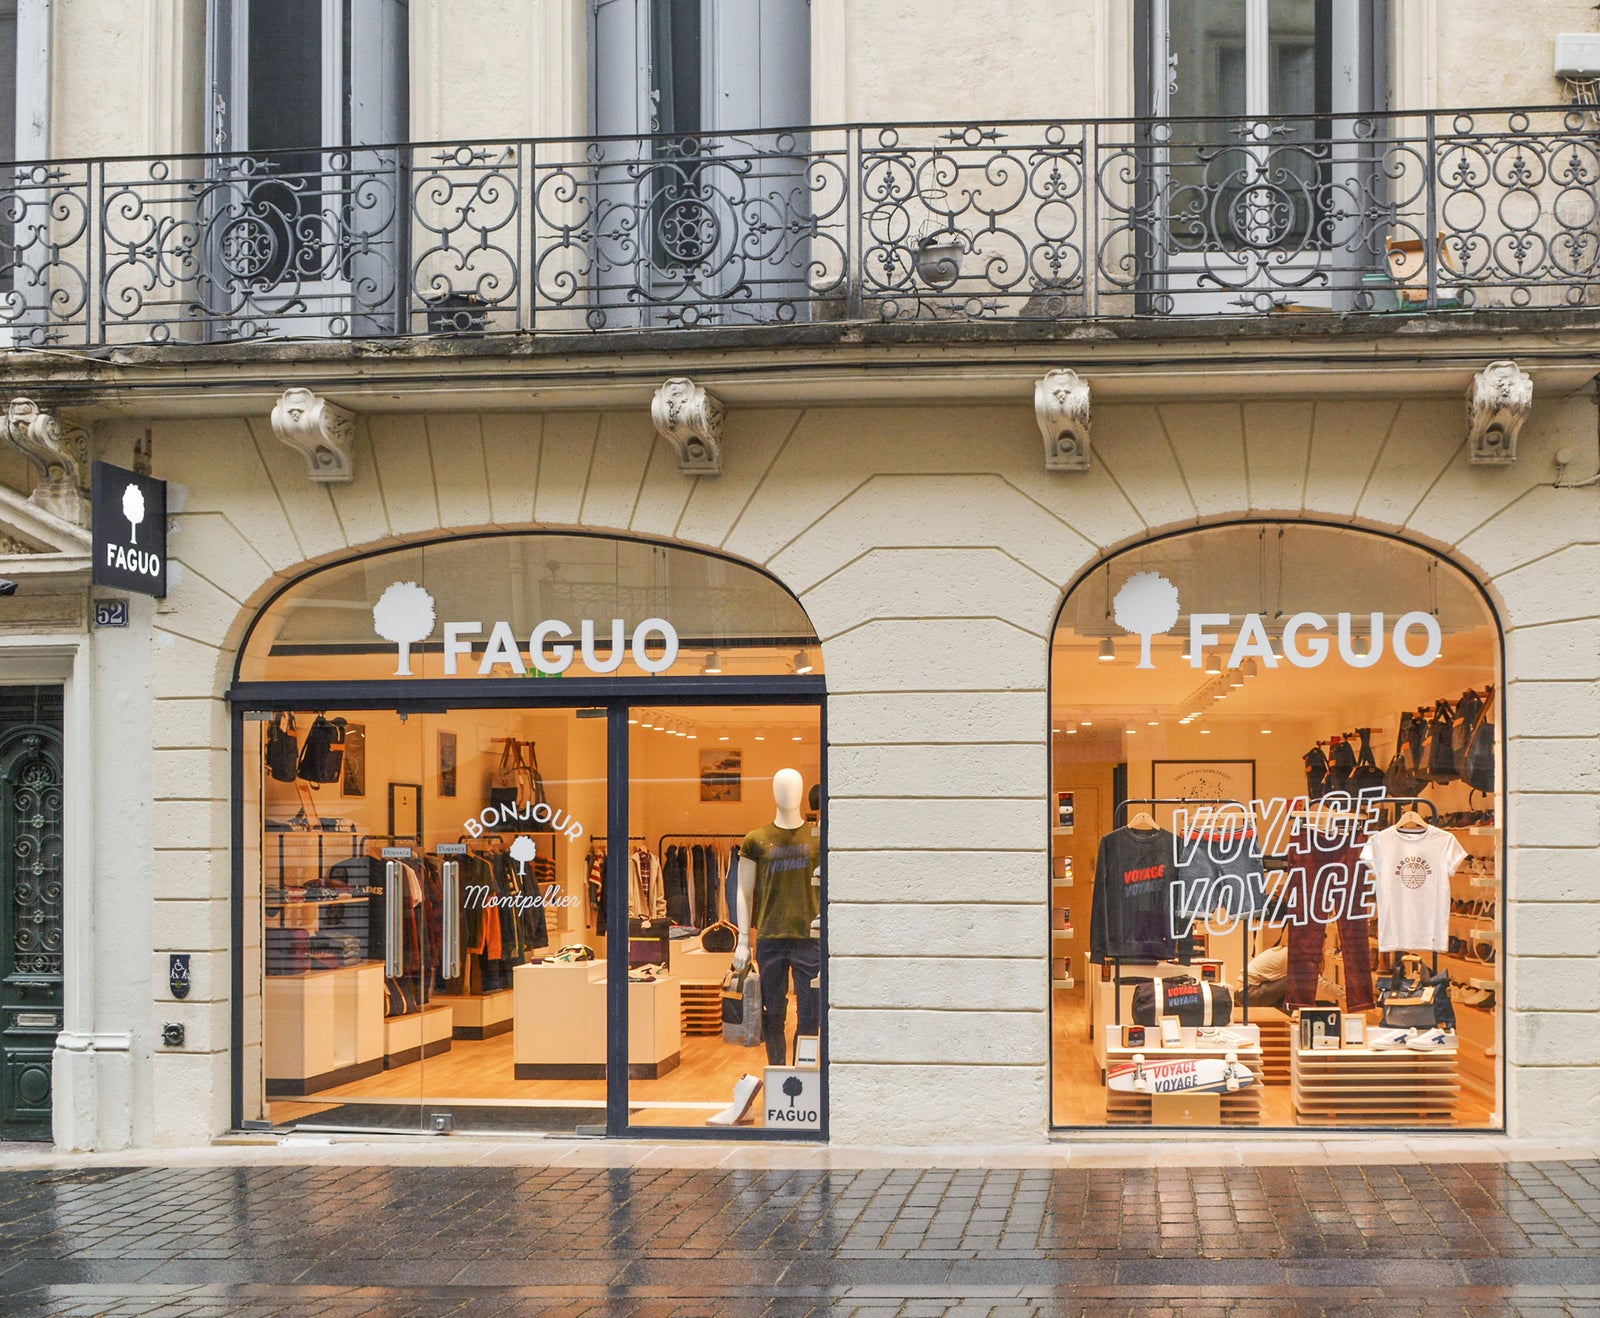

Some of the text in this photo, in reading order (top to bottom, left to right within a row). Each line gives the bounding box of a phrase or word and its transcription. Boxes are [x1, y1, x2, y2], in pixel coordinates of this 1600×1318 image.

[107, 543, 160, 577] FAGUO
[98, 604, 123, 625] 52
[444, 618, 679, 675] FAGUO
[1190, 611, 1442, 668] FAGUO
[463, 801, 583, 843] BONJOUR
[1173, 786, 1387, 868] VOYAGE
[1124, 864, 1166, 885] VOYAGE
[1395, 856, 1433, 876] BAROUDEUR
[463, 884, 581, 917] Montpellier
[1169, 857, 1383, 940] VOYAGE
[1167, 986, 1199, 998] VOYAGE
[1168, 995, 1199, 1007] VOYAGE
[1153, 1061, 1197, 1079] VOYAGE
[1155, 1075, 1198, 1093] VOYAGE
[768, 1109, 817, 1123] FAGUO
